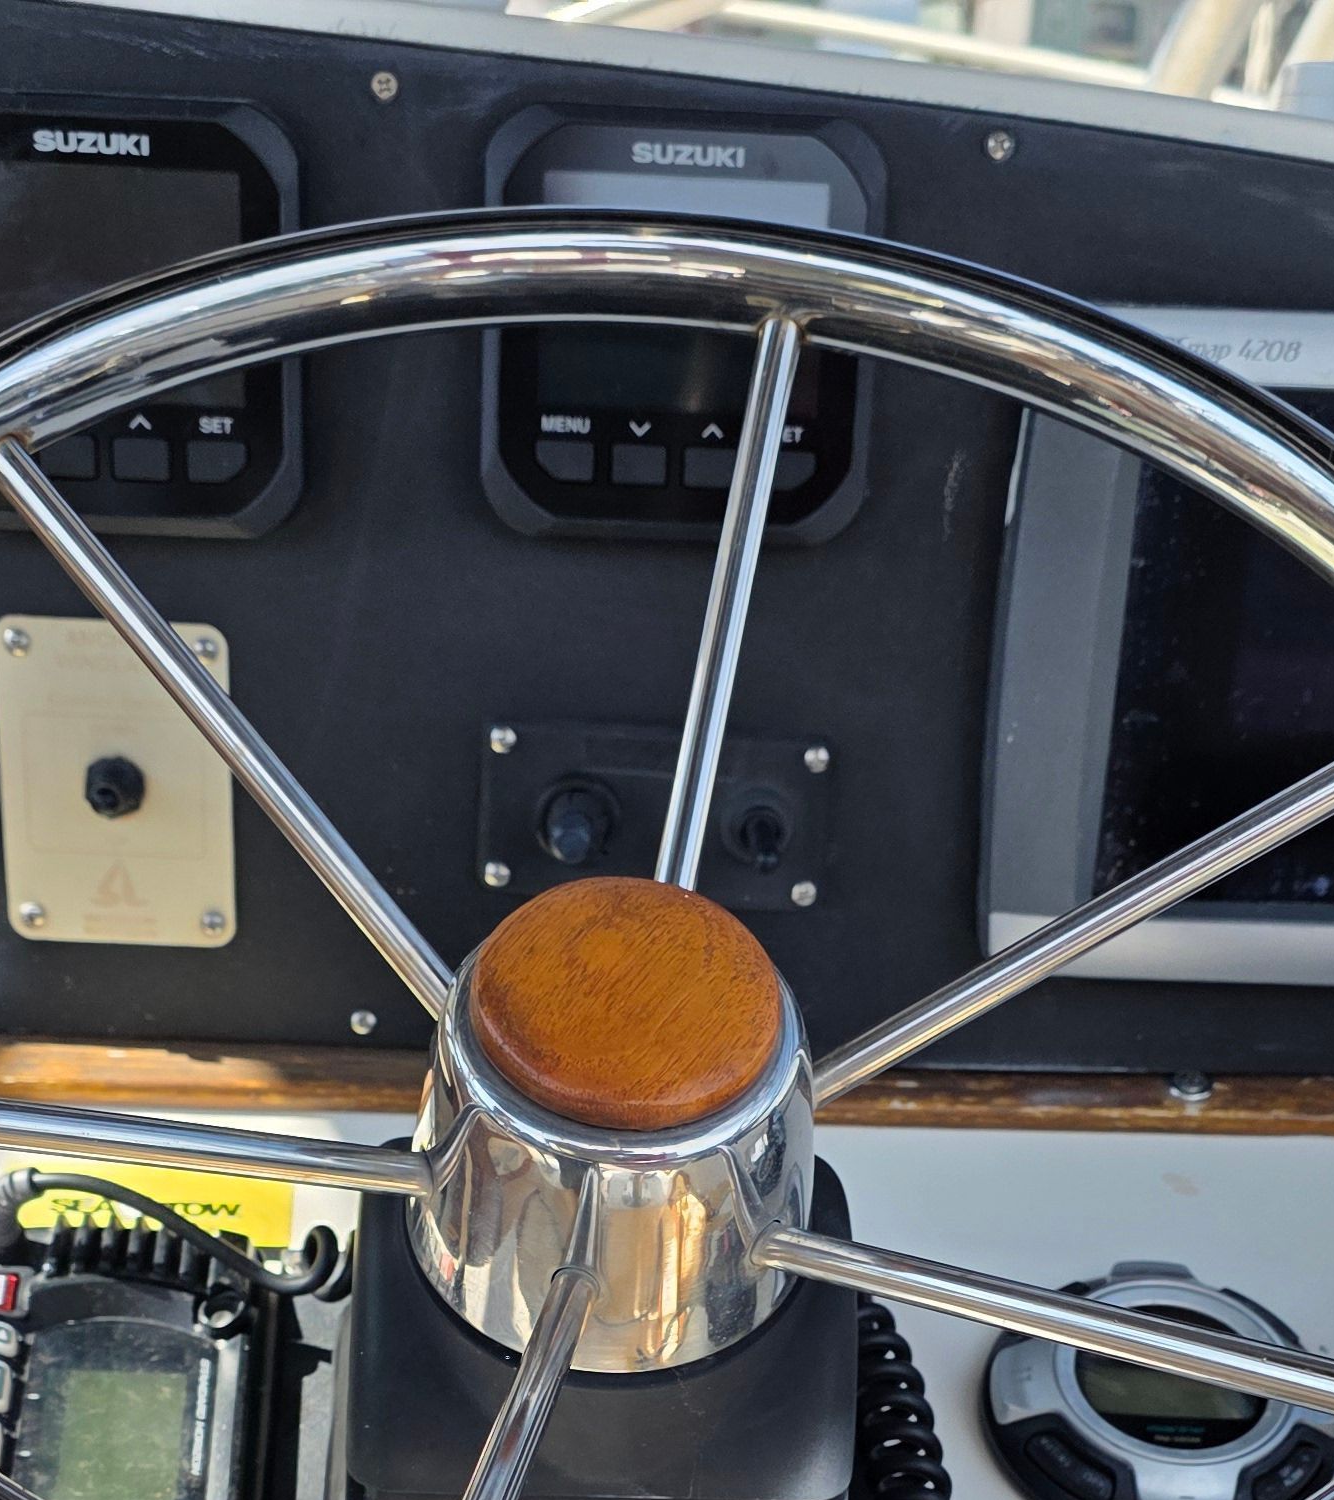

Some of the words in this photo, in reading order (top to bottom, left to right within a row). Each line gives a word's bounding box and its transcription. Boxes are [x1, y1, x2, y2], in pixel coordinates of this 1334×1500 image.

[33, 129, 150, 157] SUZUKI
[631, 141, 746, 169] SUZUKI
[1237, 337, 1303, 363] 4208
[198, 415, 233, 435] SET
[540, 414, 591, 435] MENU
[781, 426, 804, 445] ET
